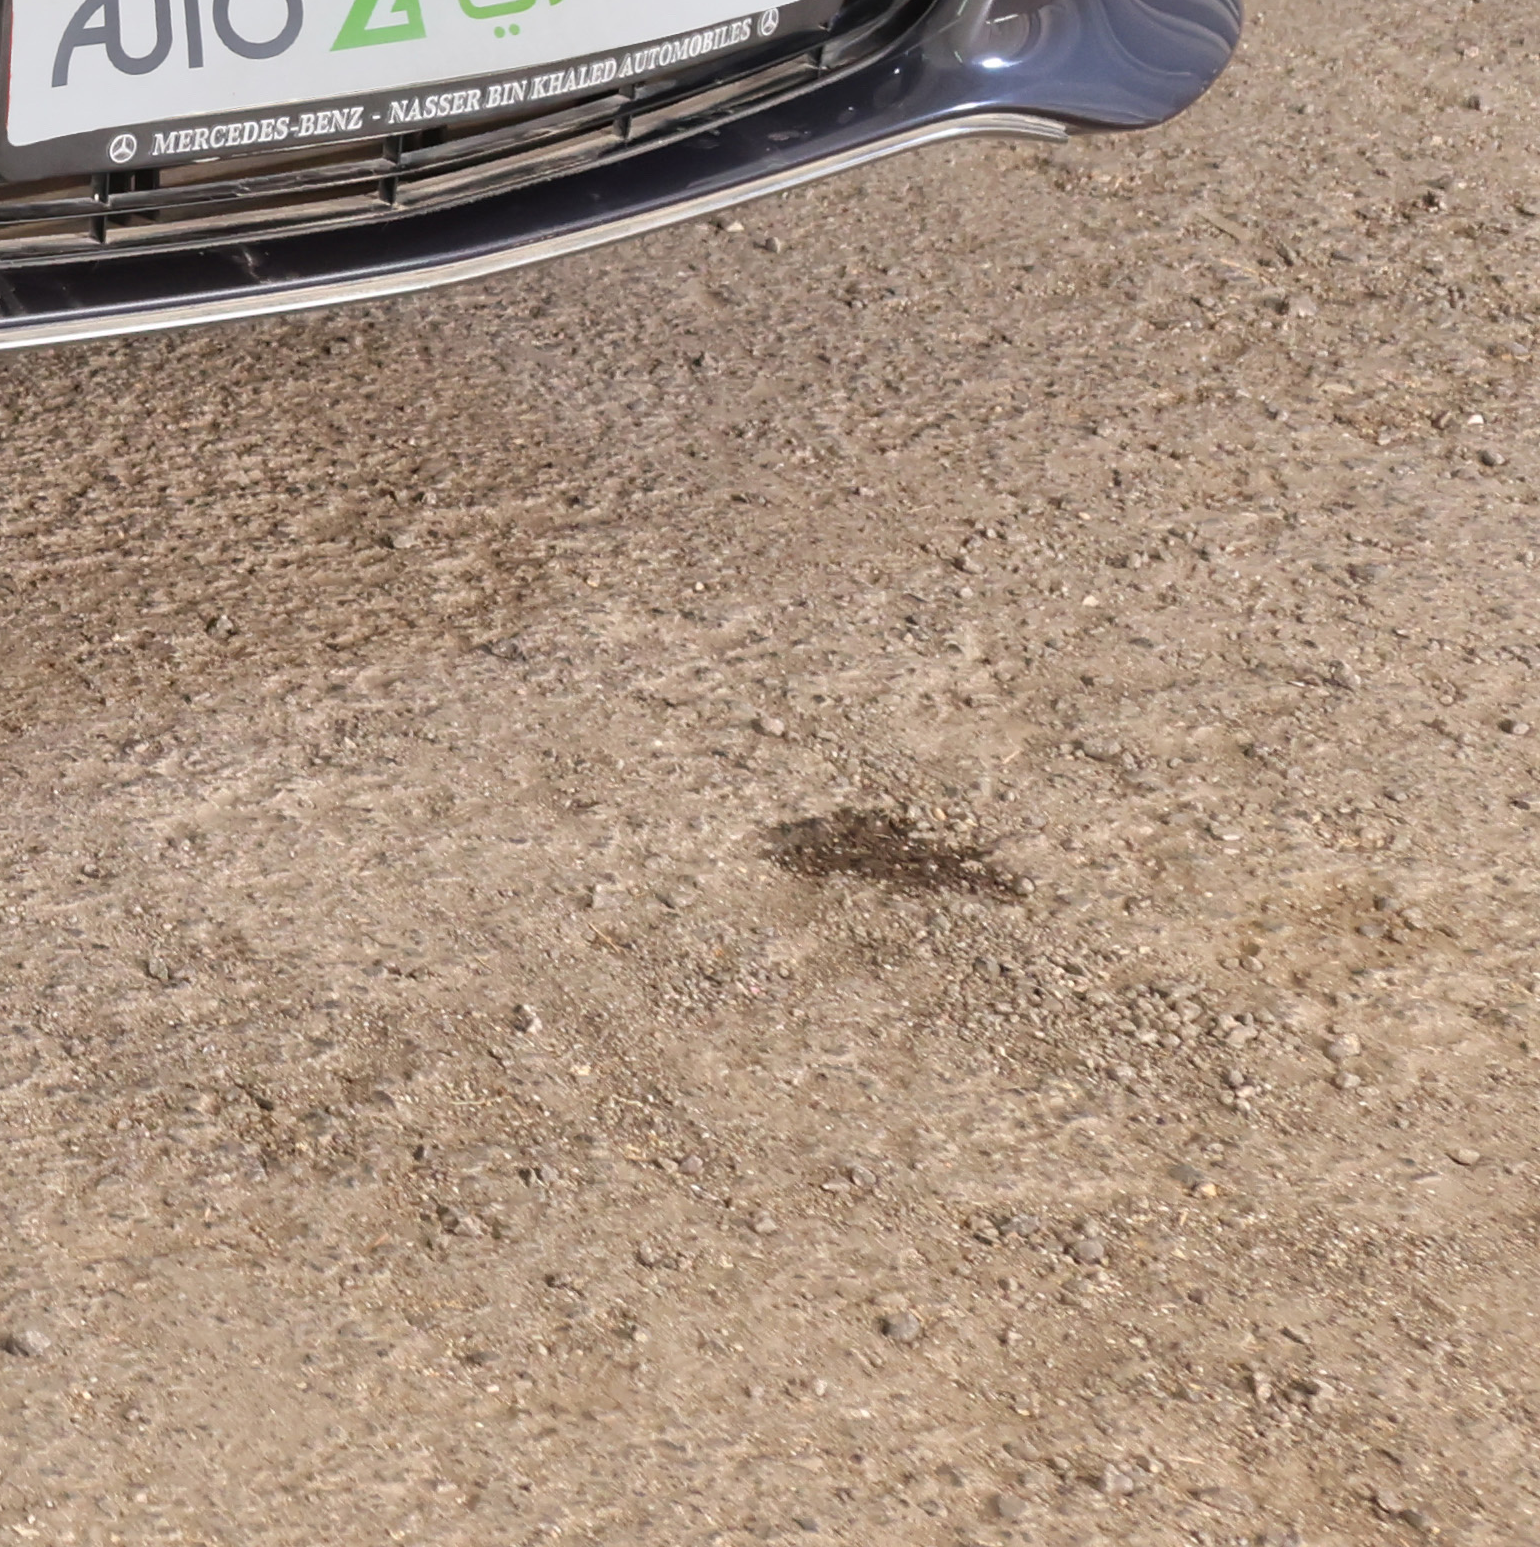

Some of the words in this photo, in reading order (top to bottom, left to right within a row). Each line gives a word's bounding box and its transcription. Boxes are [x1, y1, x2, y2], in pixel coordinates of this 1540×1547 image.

[151, 106, 365, 156] MERCEDES-BENZ
[387, 89, 482, 124] NASSER
[484, 79, 528, 108] BIN
[529, 56, 618, 100] KHALED
[618, 17, 753, 79] AUTOMOBILES
